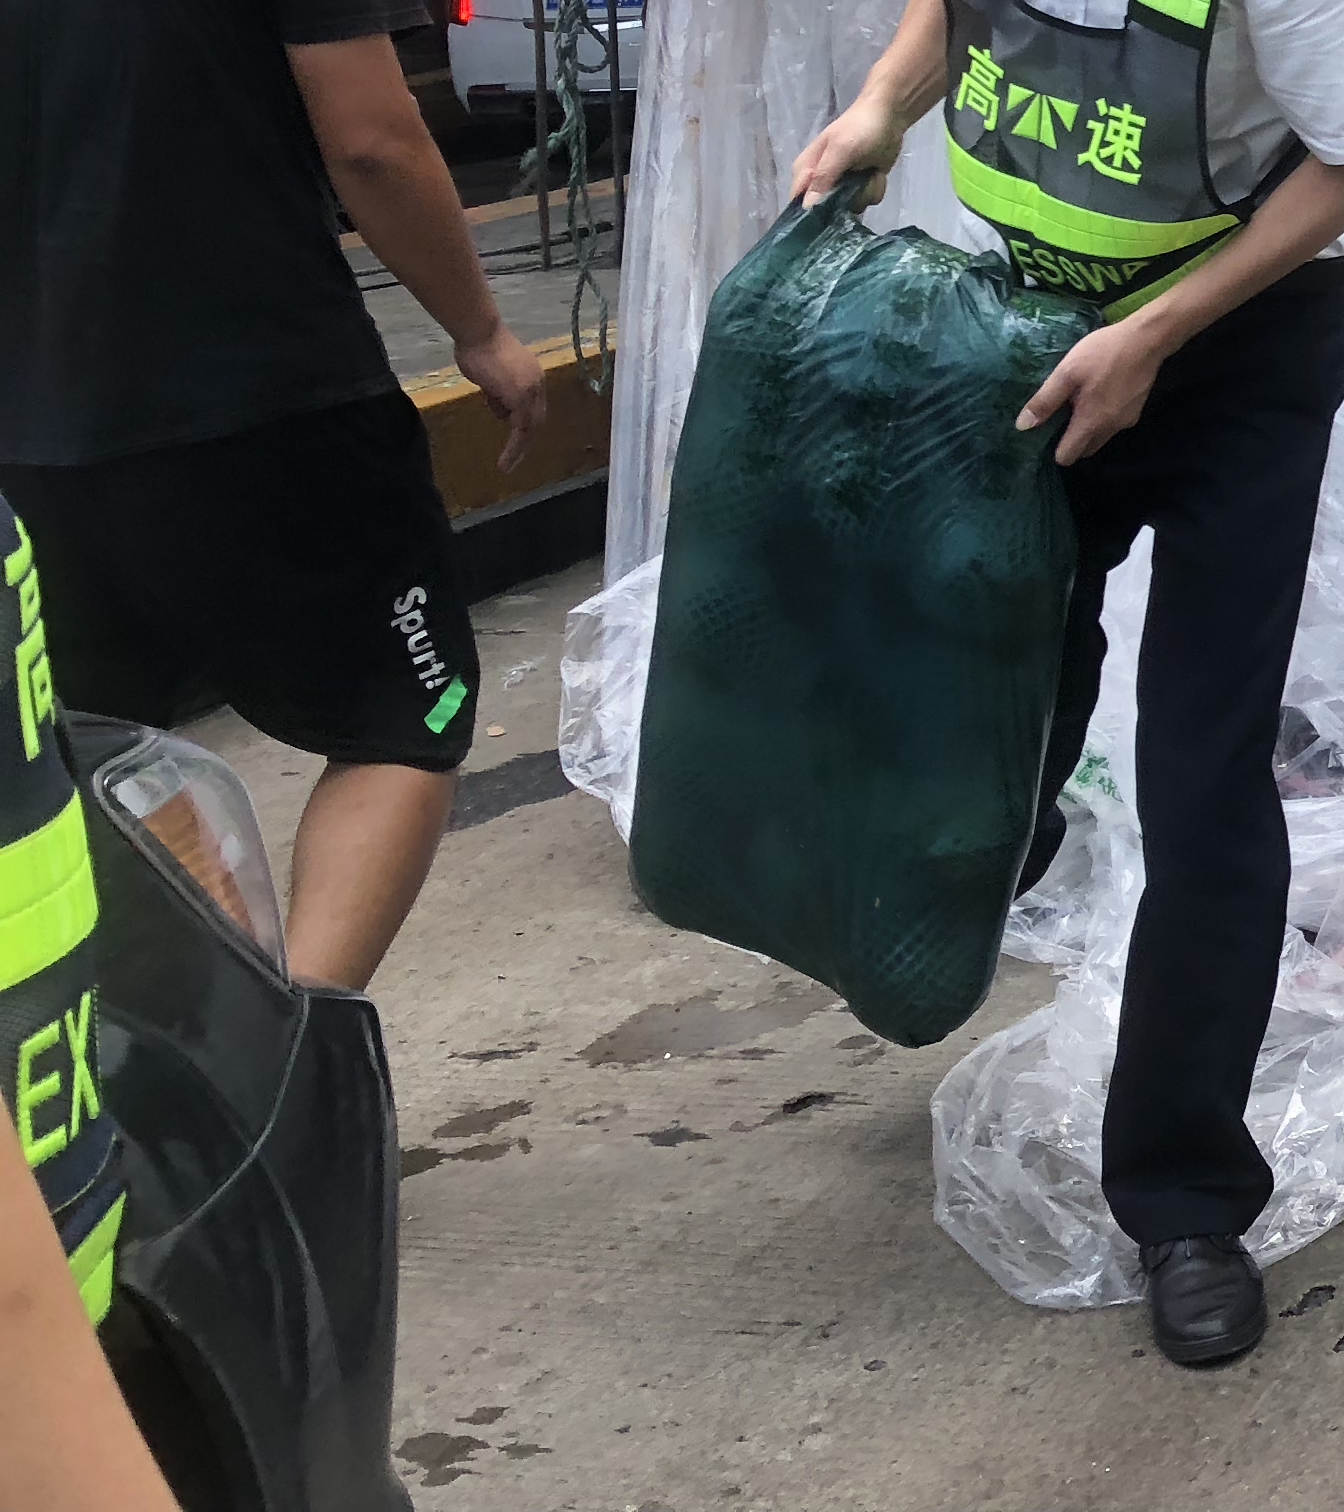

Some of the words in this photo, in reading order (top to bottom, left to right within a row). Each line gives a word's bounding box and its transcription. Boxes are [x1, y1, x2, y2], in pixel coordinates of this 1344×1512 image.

[954, 44, 1005, 132] 高
[1077, 97, 1147, 186] 速
[390, 586, 451, 690] Spurt!
